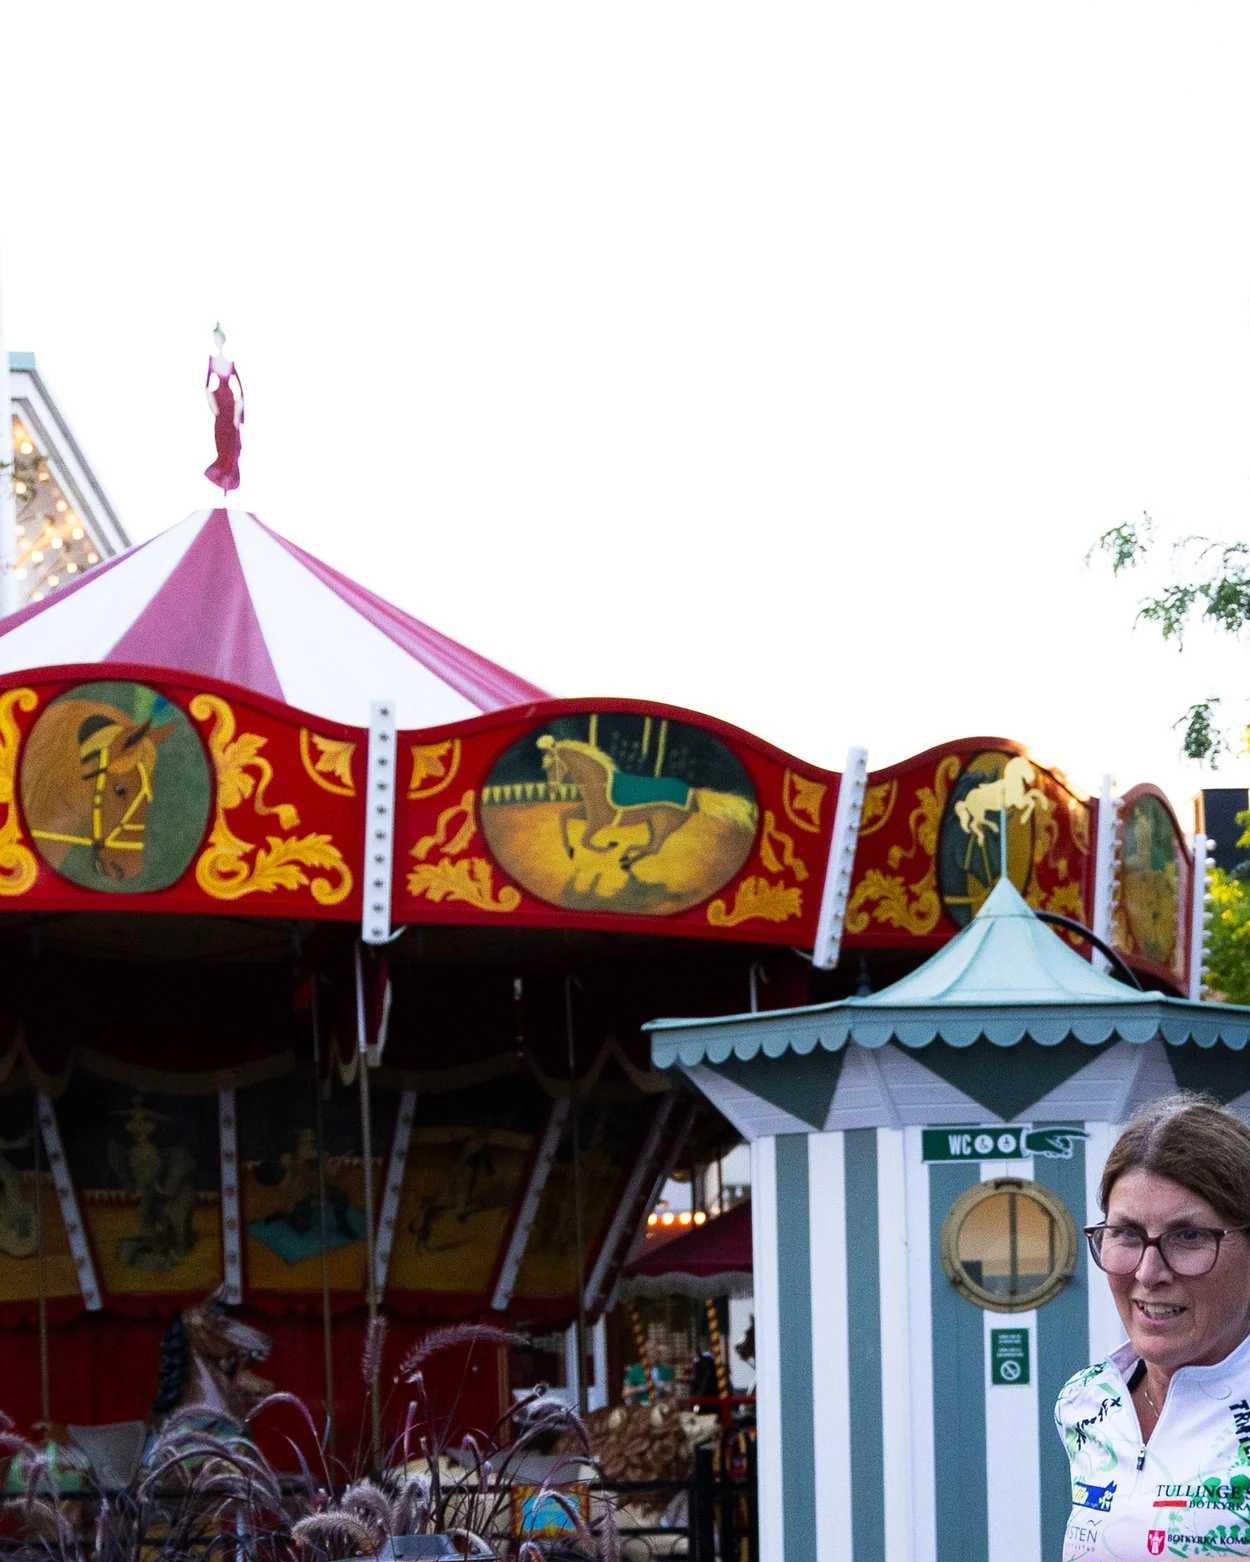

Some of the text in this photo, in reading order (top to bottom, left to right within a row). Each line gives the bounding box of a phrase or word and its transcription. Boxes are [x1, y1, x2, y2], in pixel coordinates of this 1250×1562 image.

[948, 1134, 972, 1155] WC
[1156, 1484, 1241, 1500] TULLINGE
[1188, 1501, 1250, 1511] BOTKYRKA
[1167, 1533, 1216, 1545] BOTKYRKA
